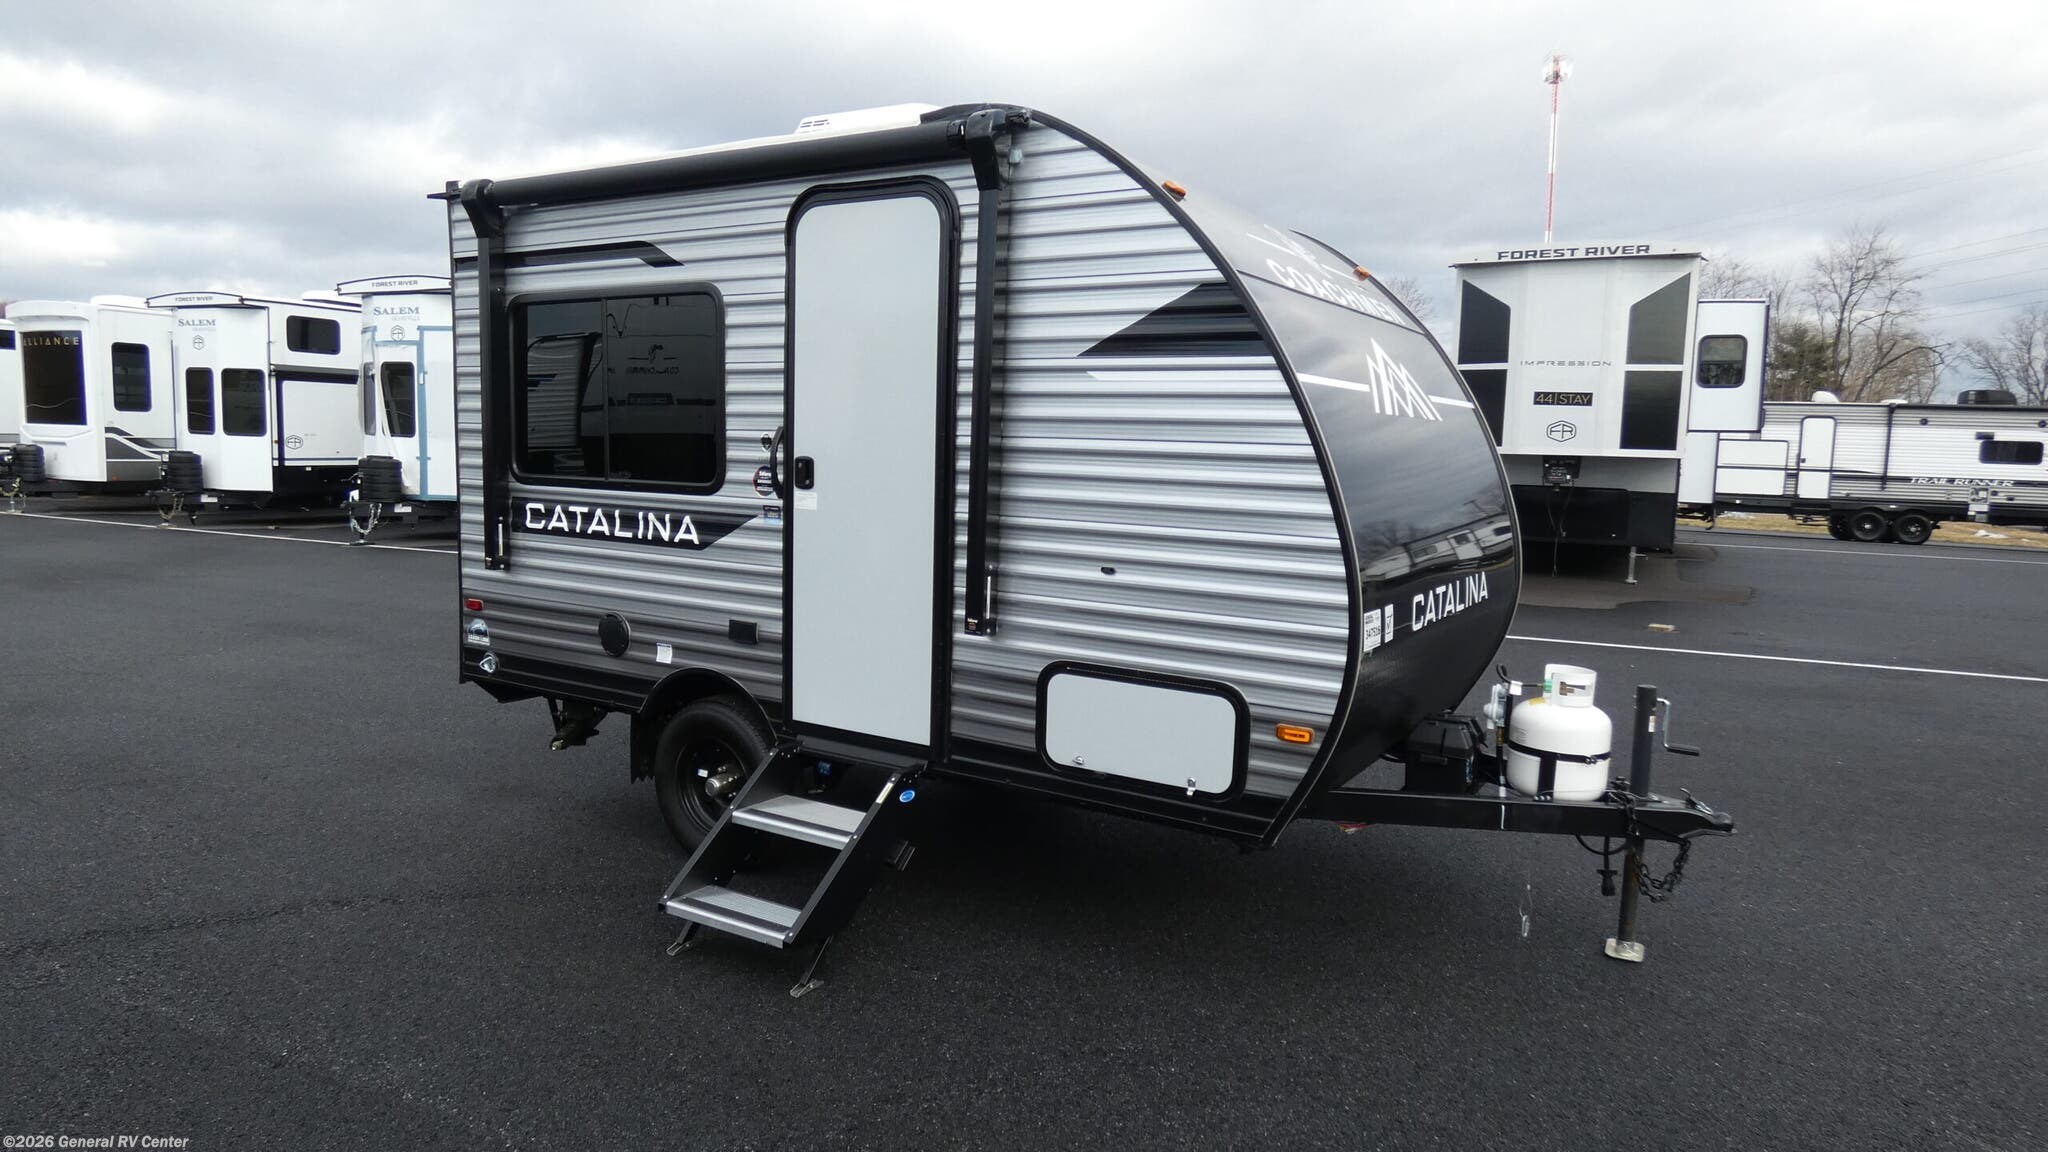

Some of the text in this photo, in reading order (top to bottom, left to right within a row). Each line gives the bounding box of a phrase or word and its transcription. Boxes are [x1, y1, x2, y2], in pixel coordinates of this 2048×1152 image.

[1497, 244, 1651, 261] FOREST RIVER
[371, 280, 397, 288] FOREST
[1265, 257, 1406, 326] COACHMEN
[373, 306, 420, 316] SALEM
[177, 317, 216, 327] SALEM
[1520, 359, 1612, 367] IMPRESSION
[1909, 477, 2015, 488] TRAIL RUNNER
[524, 502, 700, 546] CATALINA
[1411, 570, 1489, 632] CATALINA
